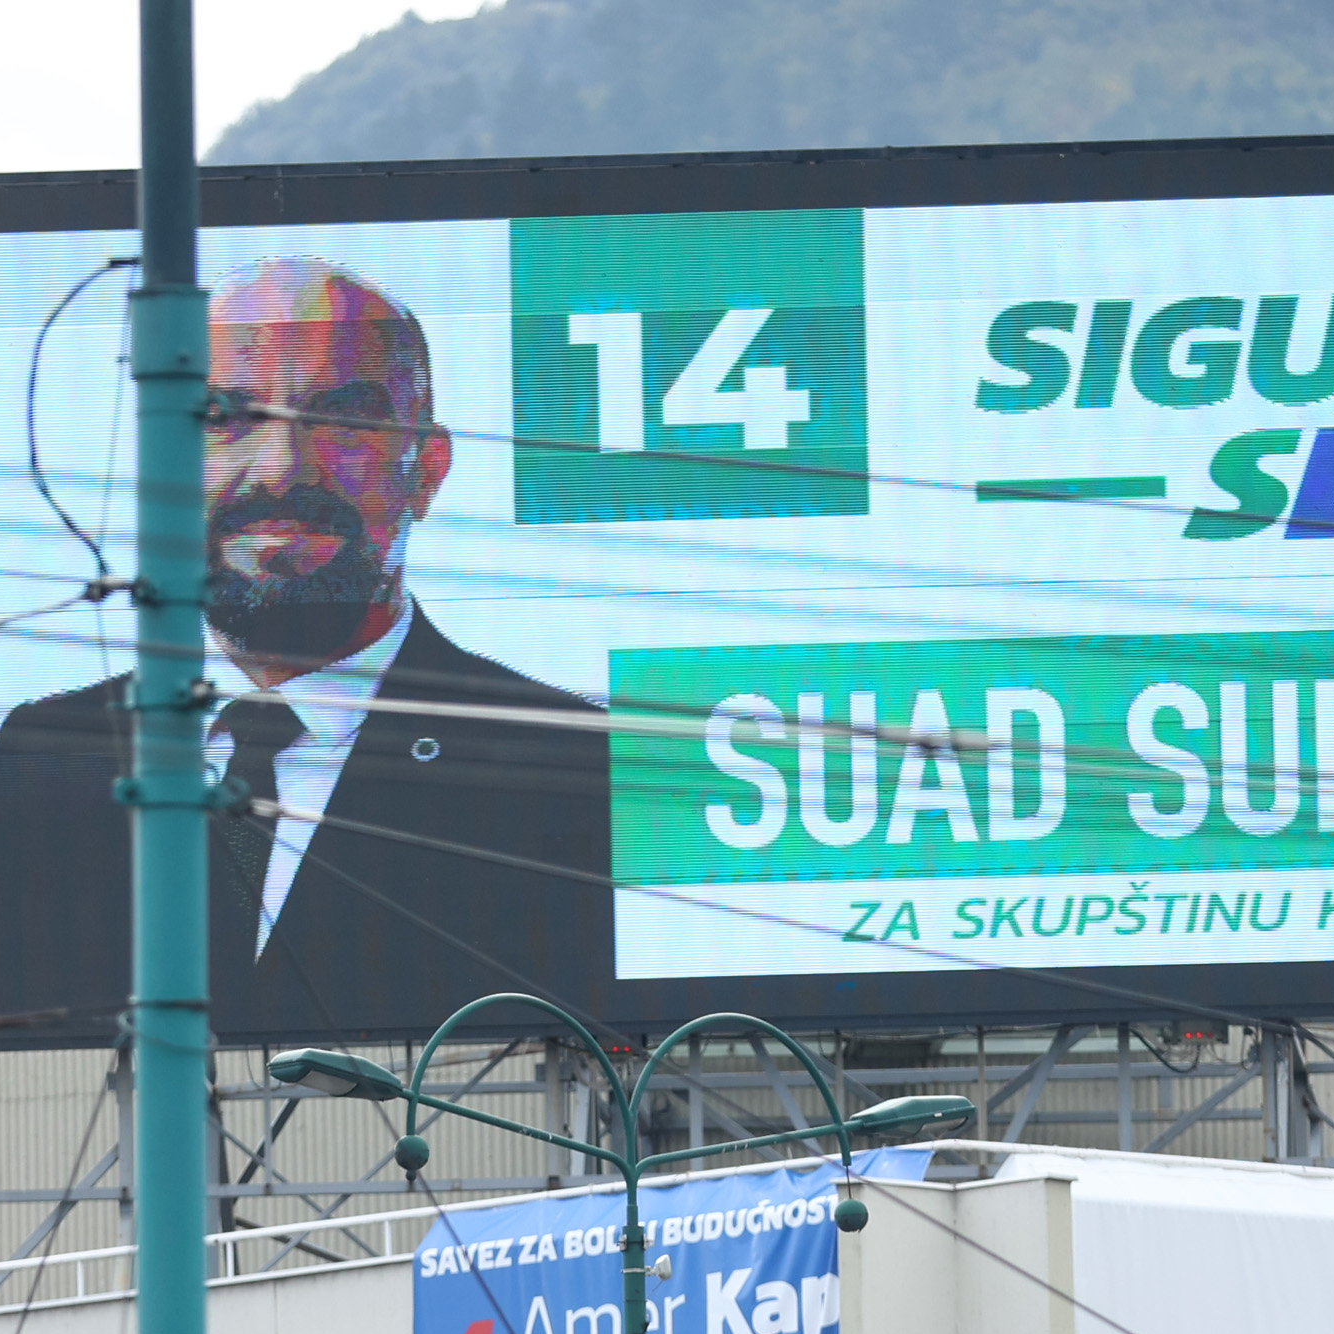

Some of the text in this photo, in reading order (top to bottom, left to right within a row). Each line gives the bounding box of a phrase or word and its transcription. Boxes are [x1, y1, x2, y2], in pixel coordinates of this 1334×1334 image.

[566, 307, 811, 453] 14
[703, 686, 1066, 850] SUAD
[842, 900, 922, 944] ZA
[951, 880, 1292, 940] SKUPŠTINU
[420, 1238, 514, 1278] SAVEZ
[518, 1233, 557, 1265] ZA
